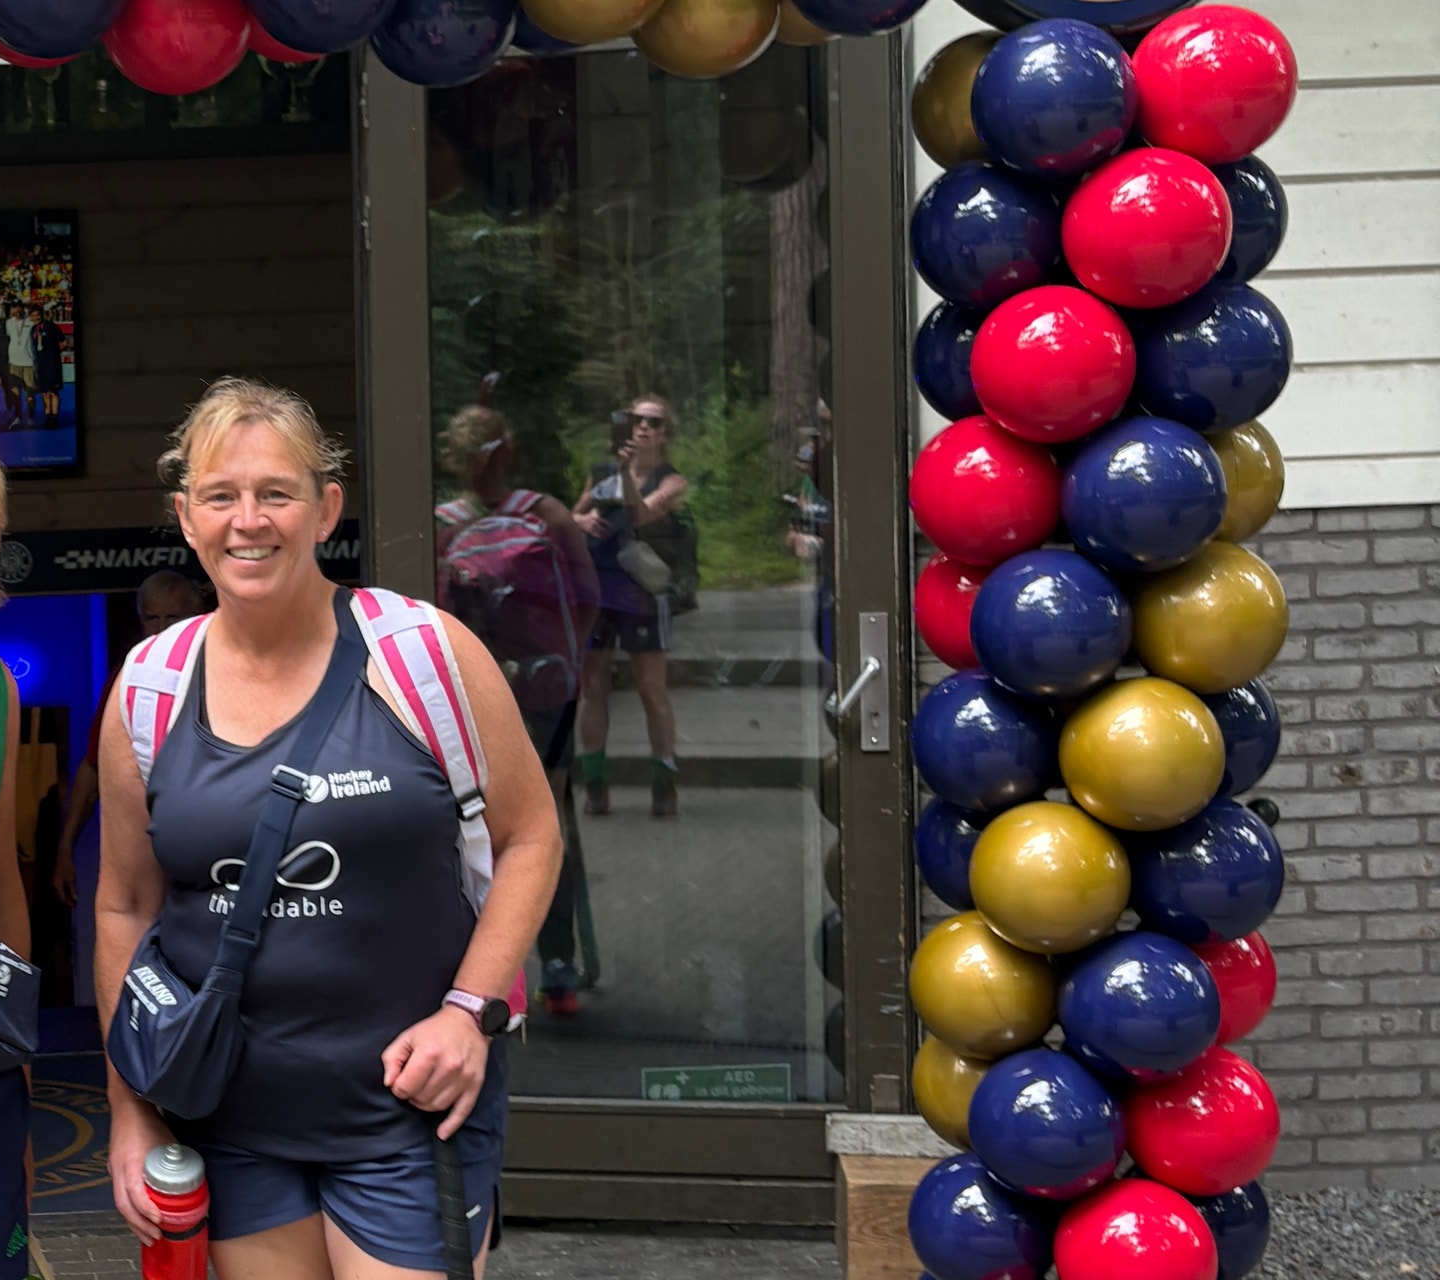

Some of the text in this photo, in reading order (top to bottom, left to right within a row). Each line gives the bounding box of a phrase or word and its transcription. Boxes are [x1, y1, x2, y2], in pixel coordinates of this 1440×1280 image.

[327, 769, 373, 784] Hockey
[330, 775, 392, 799] Ireland
[724, 1070, 756, 1083] AED
